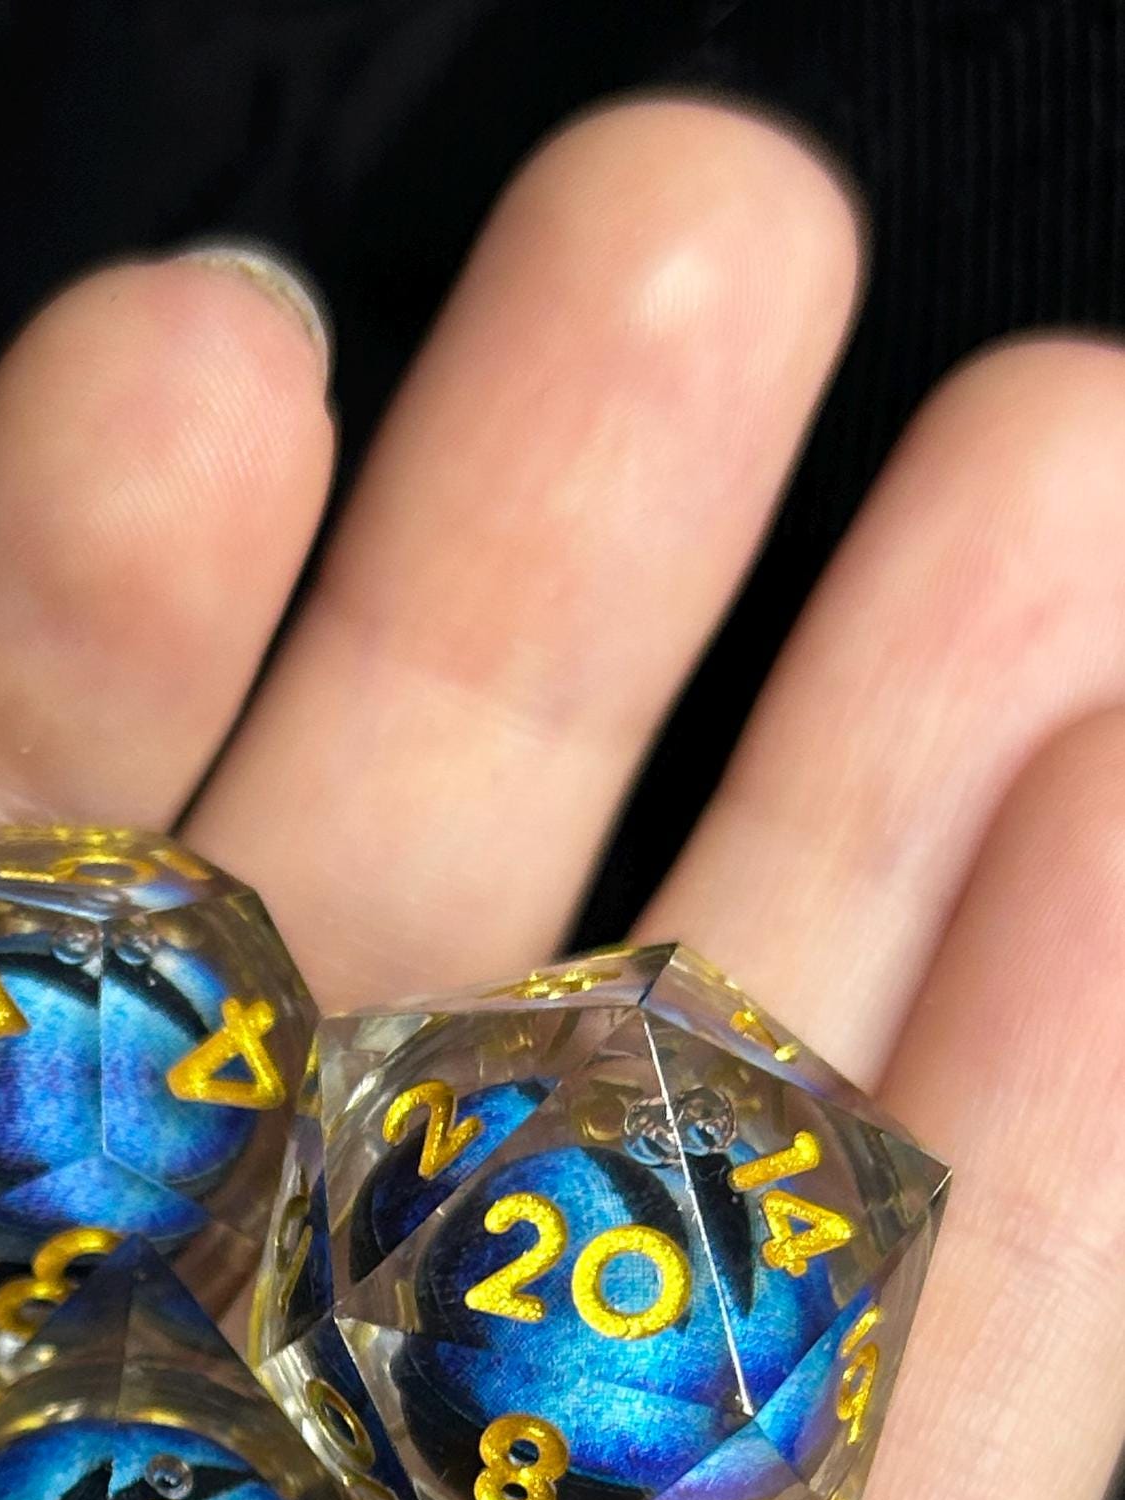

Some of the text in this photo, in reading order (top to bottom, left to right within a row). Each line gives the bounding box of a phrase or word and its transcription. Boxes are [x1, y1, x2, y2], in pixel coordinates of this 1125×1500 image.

[167, 997, 286, 1110] 4
[383, 1082, 483, 1180] 2
[465, 1193, 691, 1340] 20
[729, 1131, 854, 1275] 14
